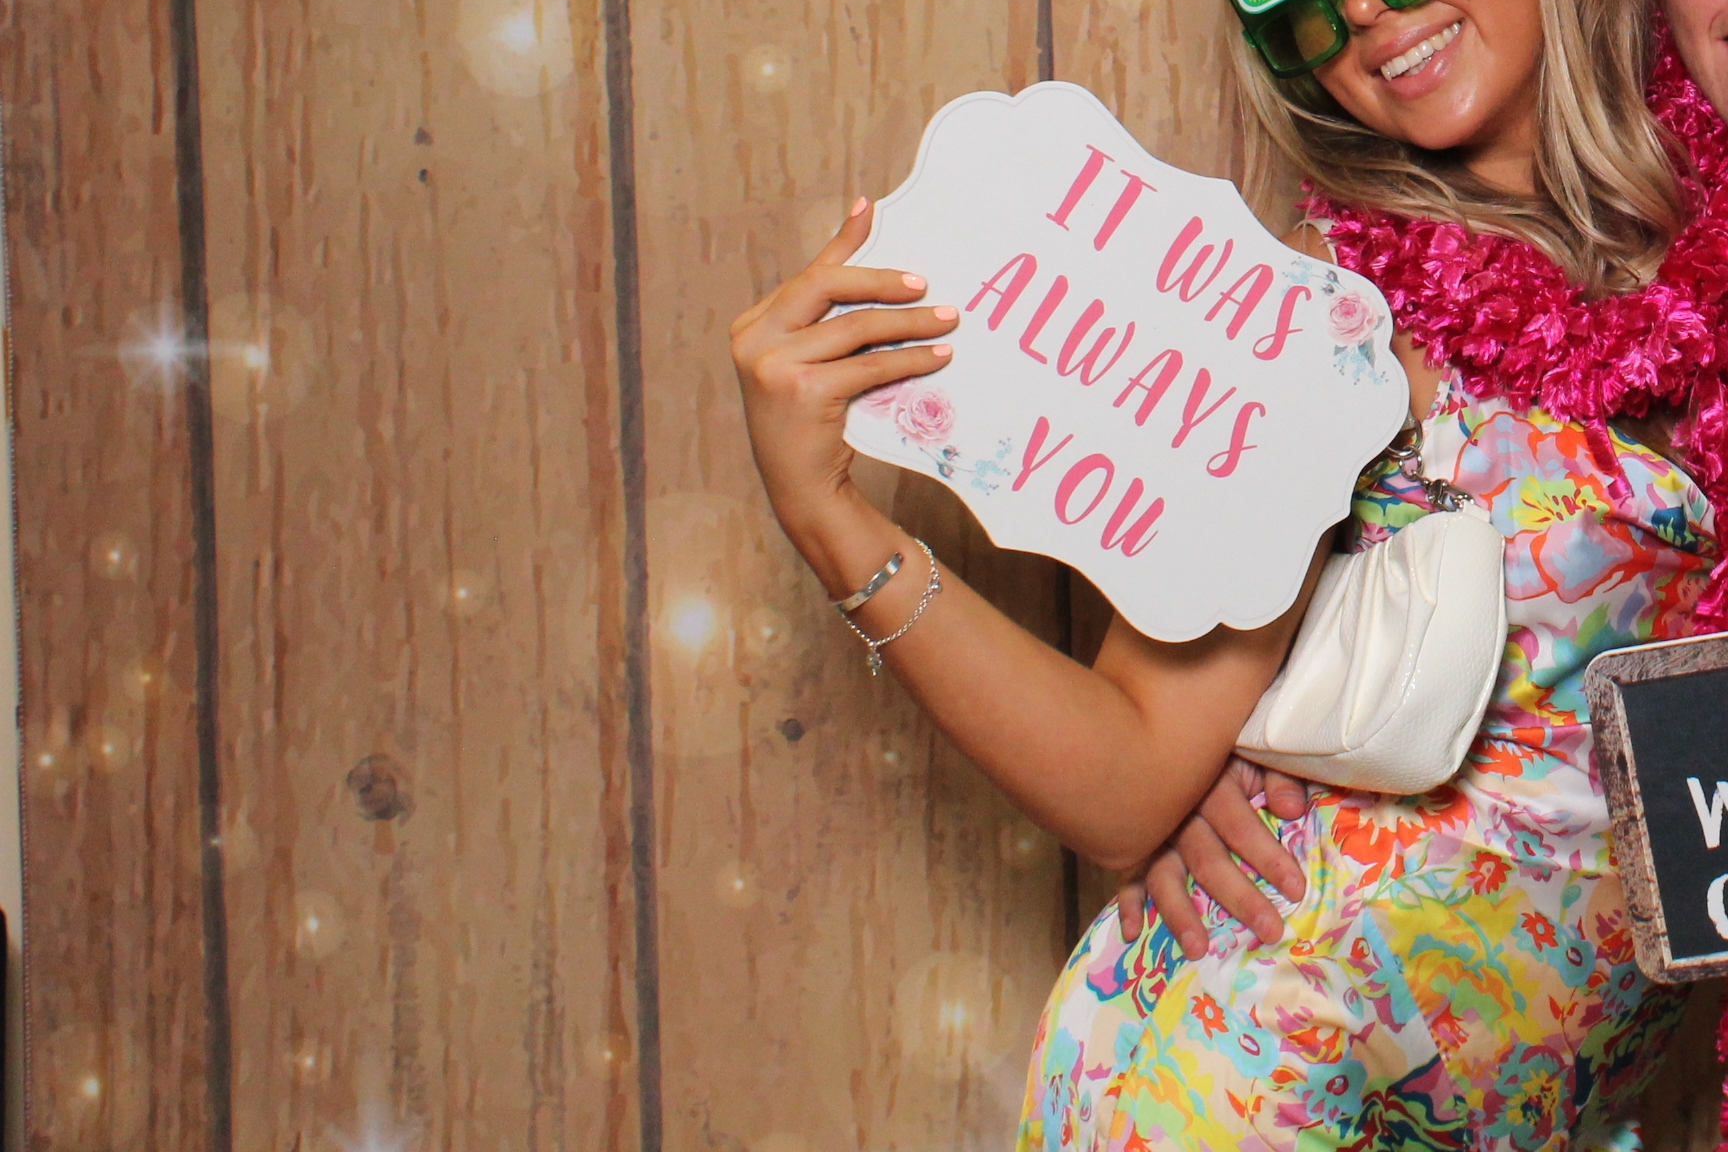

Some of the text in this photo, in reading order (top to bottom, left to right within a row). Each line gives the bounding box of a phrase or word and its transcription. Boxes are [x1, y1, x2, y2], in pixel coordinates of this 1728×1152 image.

[1046, 144, 1312, 361] IT WAS
[965, 252, 1266, 478] ALWAYS
[1012, 416, 1166, 557] YOU
